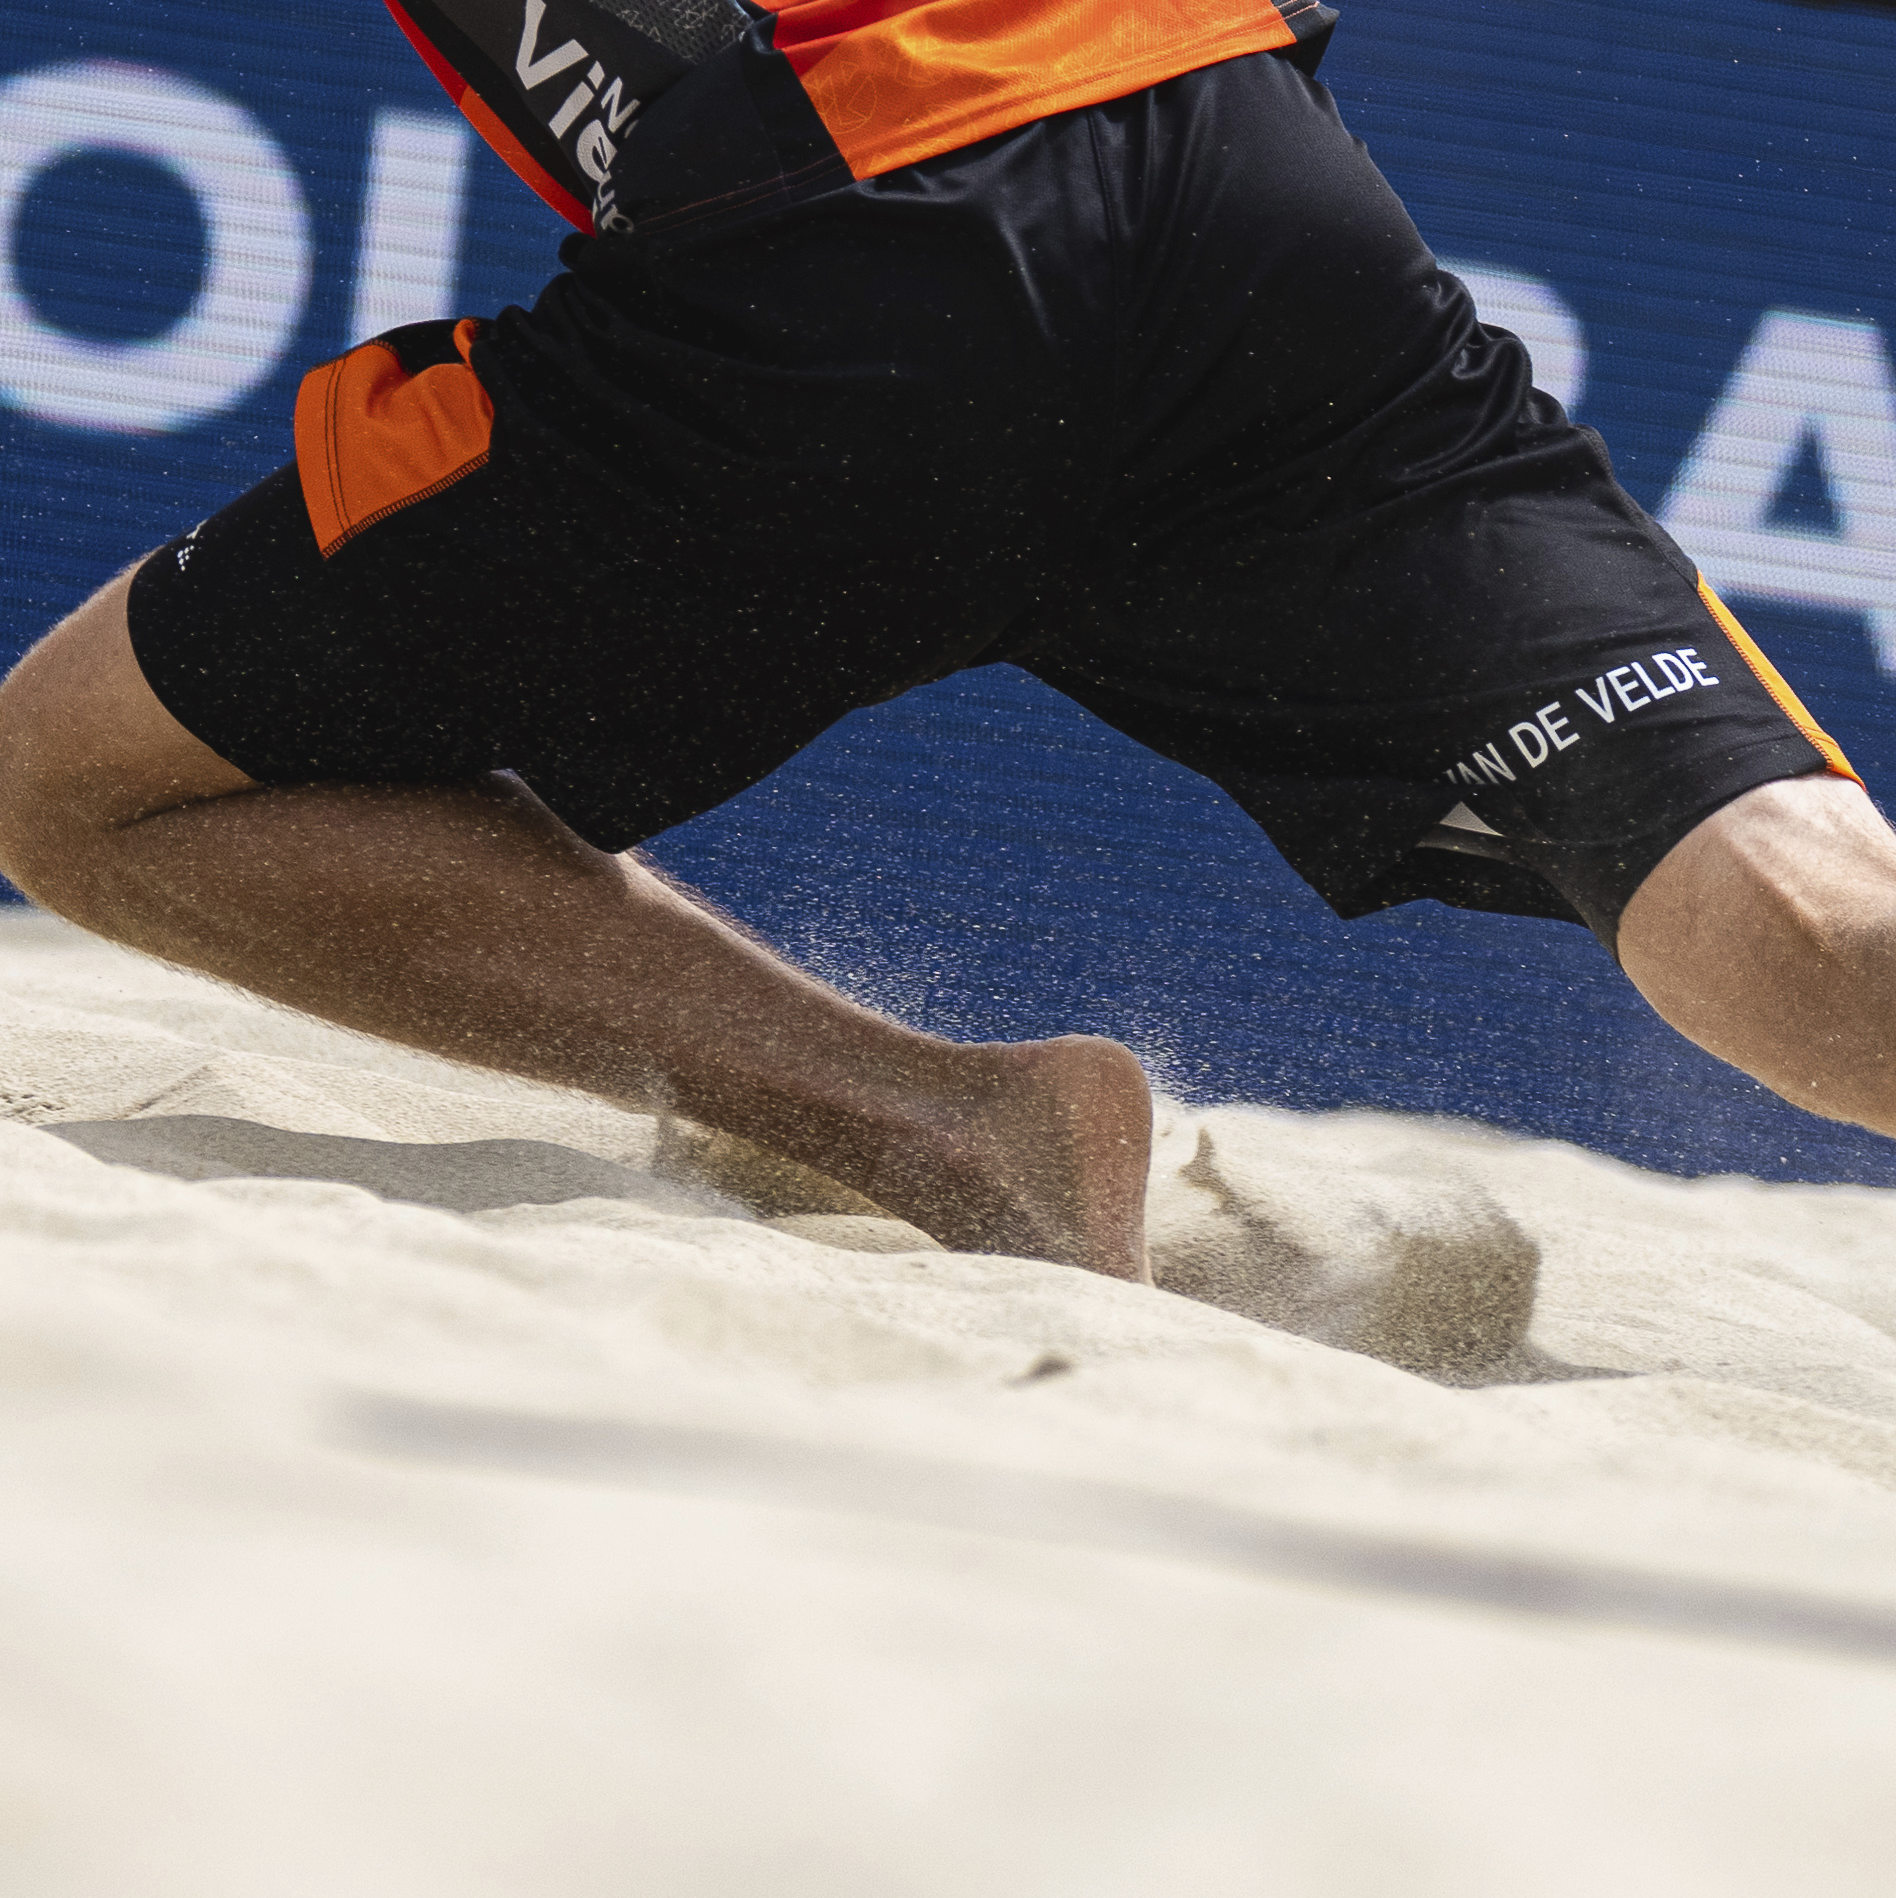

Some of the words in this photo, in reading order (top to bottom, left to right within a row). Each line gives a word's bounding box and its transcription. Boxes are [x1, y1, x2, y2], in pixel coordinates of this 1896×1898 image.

[1442, 742, 1517, 786] AN
[1508, 702, 1580, 769] DE
[1575, 647, 1720, 724] VELDE
